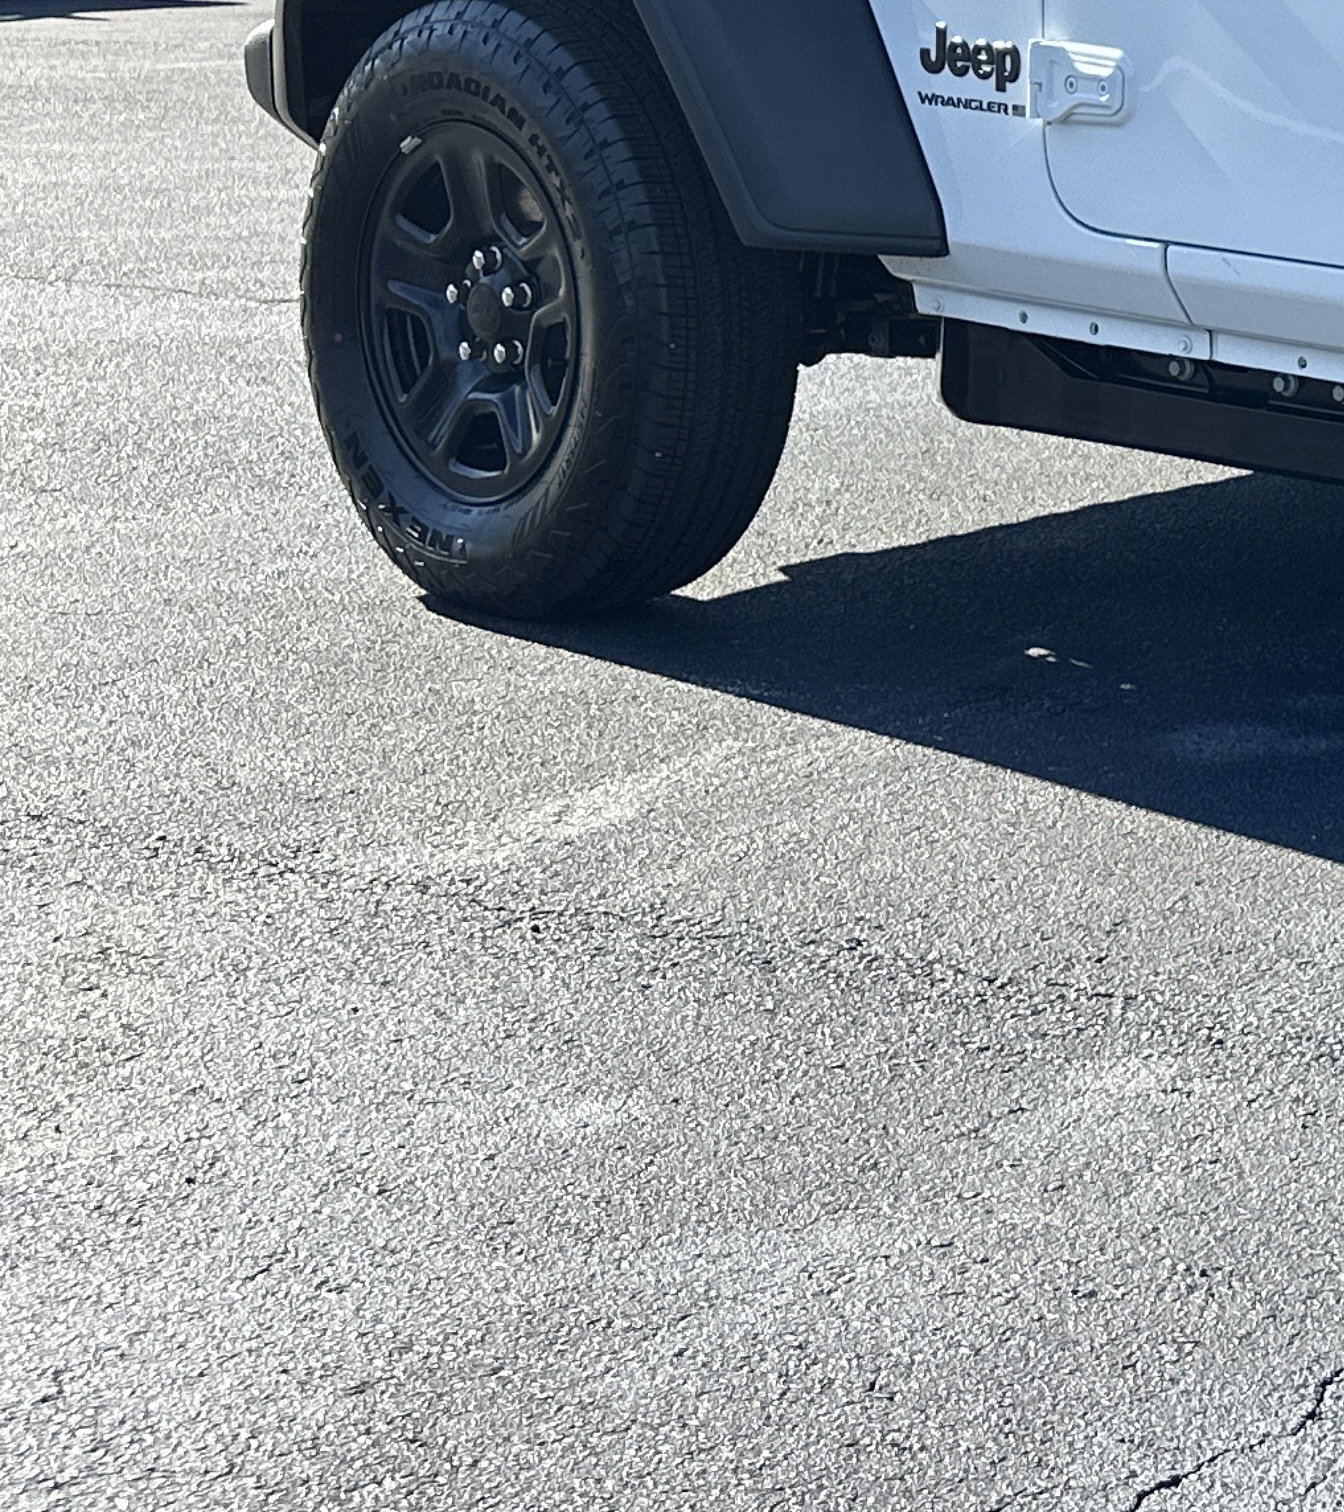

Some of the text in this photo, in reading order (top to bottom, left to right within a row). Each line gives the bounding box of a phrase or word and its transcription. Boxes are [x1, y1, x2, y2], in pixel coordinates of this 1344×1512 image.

[919, 20, 1021, 92] Jeep
[410, 71, 527, 132] ROADIAN
[917, 90, 1009, 116] WRANGLER
[346, 431, 453, 555] NEXEN
